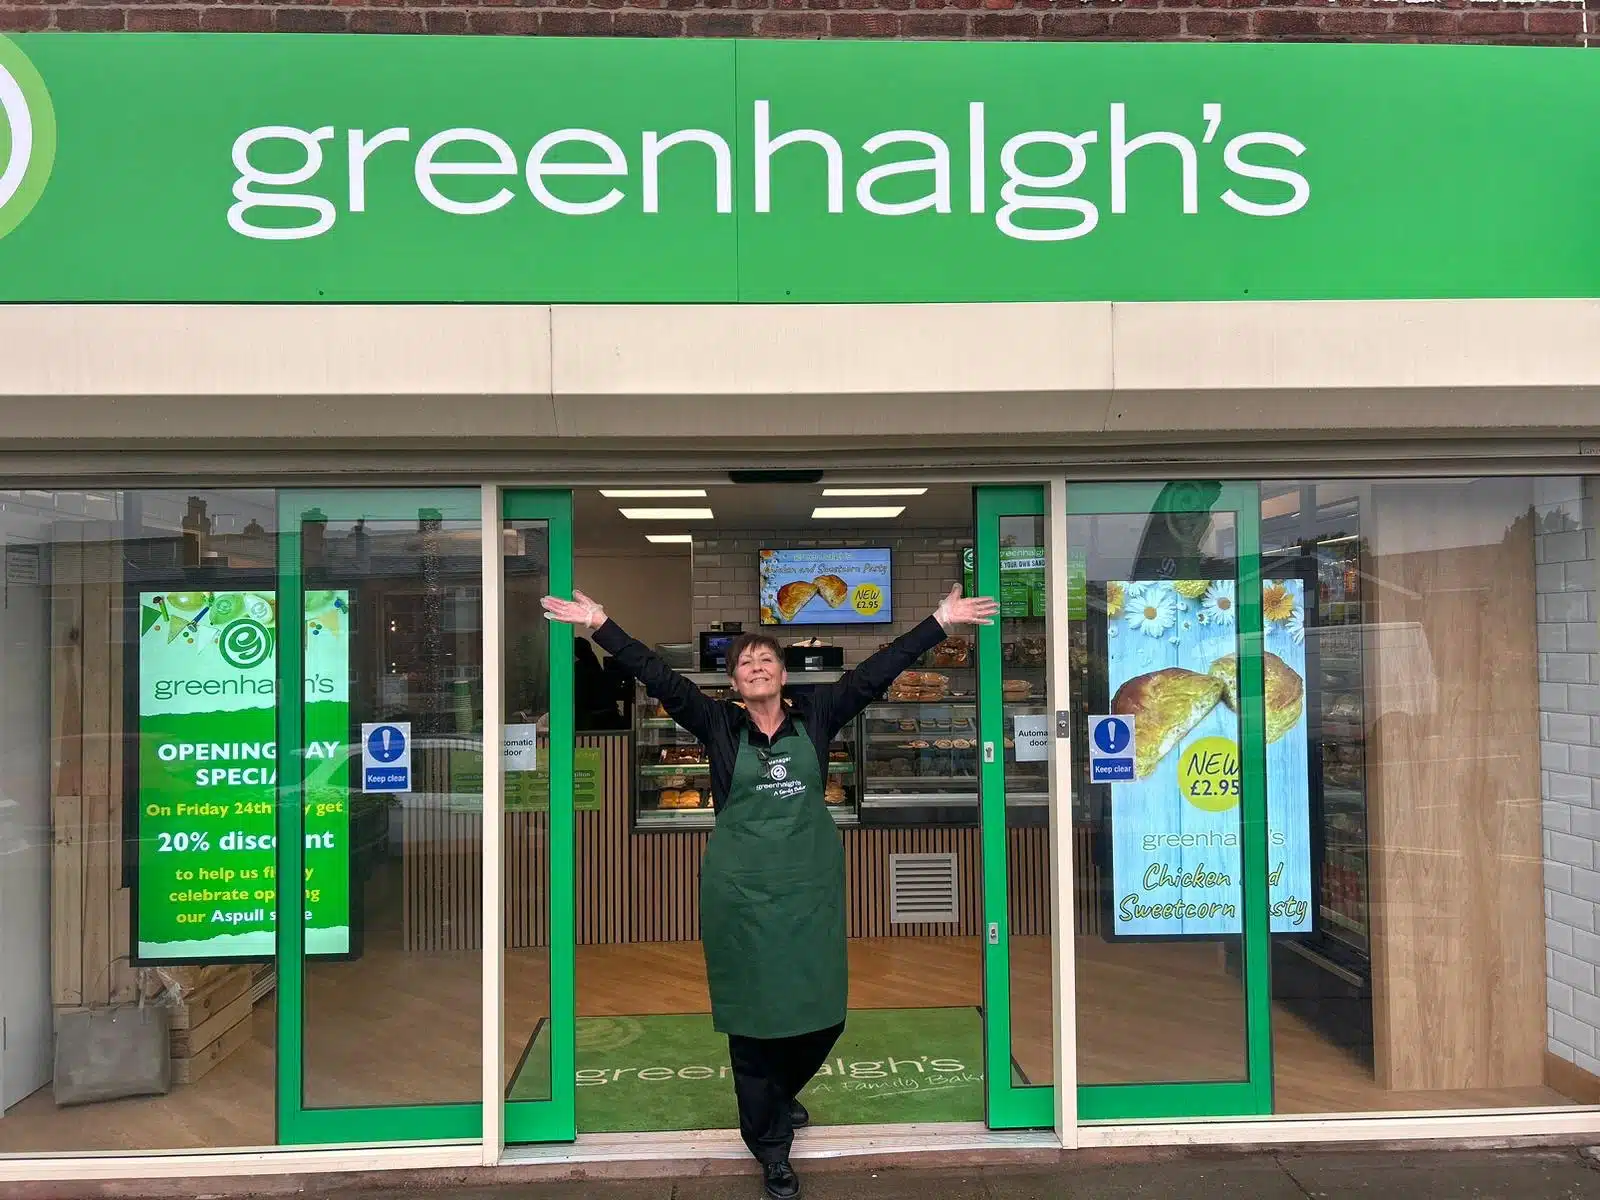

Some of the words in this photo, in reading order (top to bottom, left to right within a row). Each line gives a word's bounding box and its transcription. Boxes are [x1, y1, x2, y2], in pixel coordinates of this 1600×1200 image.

[227, 100, 1310, 241] greenhalgh's
[856, 589, 880, 599] NEW
[856, 601, 879, 609] £2.95
[155, 674, 334, 700] greenha's
[158, 742, 276, 760] OPENING
[305, 741, 340, 759] AY
[1095, 765, 1114, 774] Keep
[1114, 764, 1131, 773] clear
[1187, 751, 1239, 776] NEW
[196, 768, 276, 786] SPECI
[367, 774, 386, 783] Keep
[387, 773, 406, 783] clear
[1191, 779, 1239, 796] £2.95
[146, 804, 170, 817] On
[176, 803, 228, 818] Friday
[234, 802, 272, 814] 24th
[316, 801, 343, 816] get
[157, 831, 210, 852] 20%
[219, 831, 334, 850] discnt
[1143, 829, 1284, 850] greenha's
[175, 869, 193, 880] to
[198, 867, 234, 883] help
[240, 869, 258, 879] us
[1143, 862, 1231, 890] Chicken
[169, 888, 248, 901] celebrate
[176, 913, 206, 923] our
[211, 909, 264, 925] Aspull
[1119, 893, 1235, 922] Sweetcorn
[1268, 895, 1307, 925] sty
[925, 1073, 985, 1085] Bak
